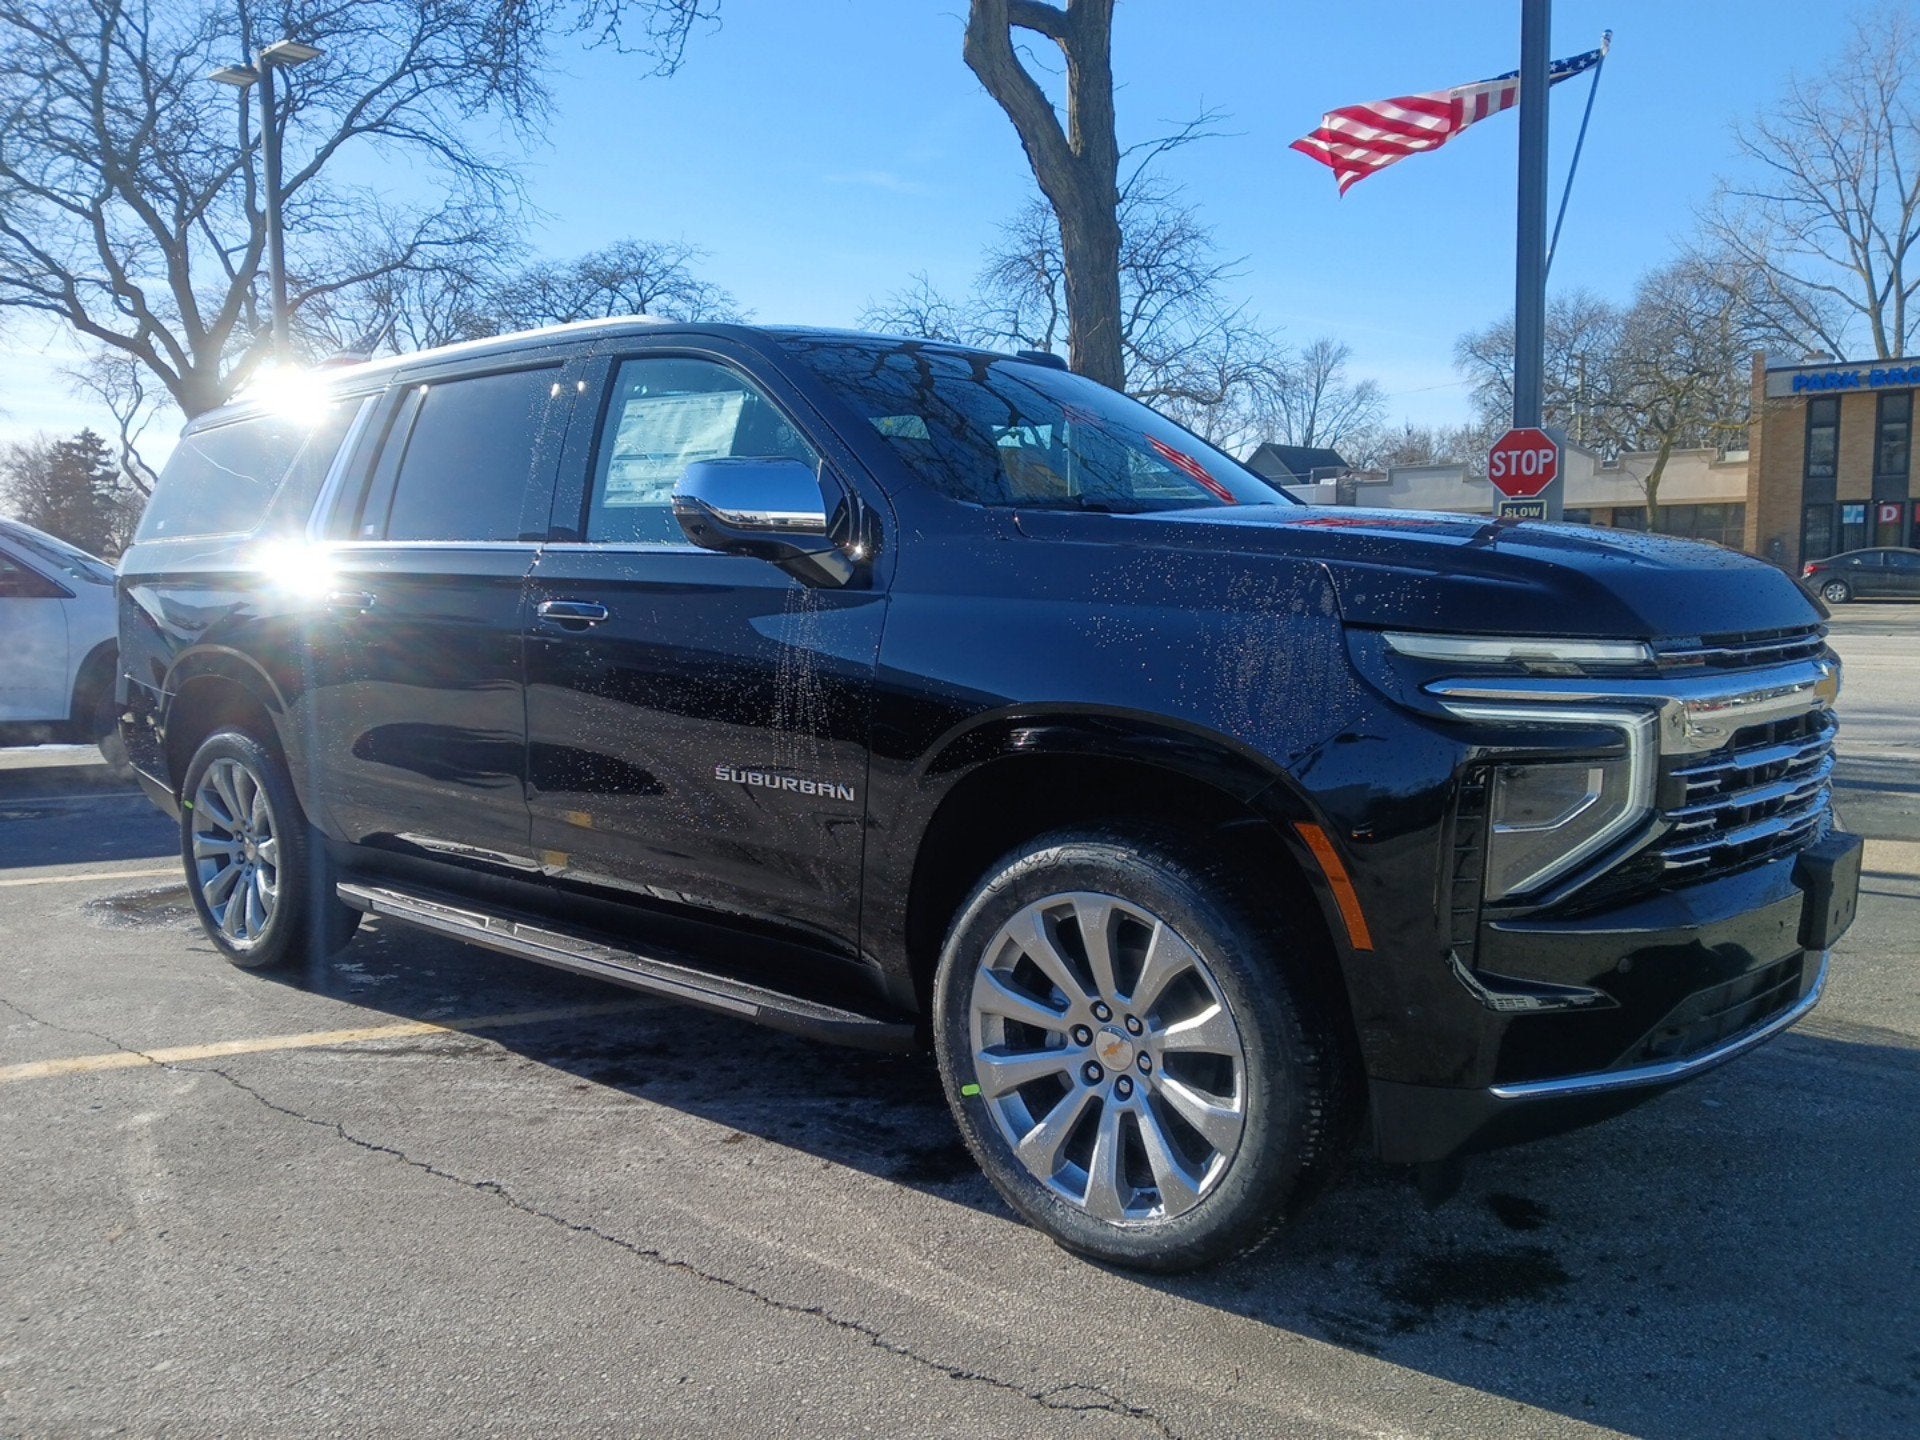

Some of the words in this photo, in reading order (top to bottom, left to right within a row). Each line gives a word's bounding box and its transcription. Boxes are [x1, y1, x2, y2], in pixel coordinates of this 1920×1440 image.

[1792, 369, 1860, 392] PARK
[1491, 449, 1554, 476] STOP
[1504, 506, 1541, 518] SLOW
[715, 767, 854, 801] SUBURBAN
